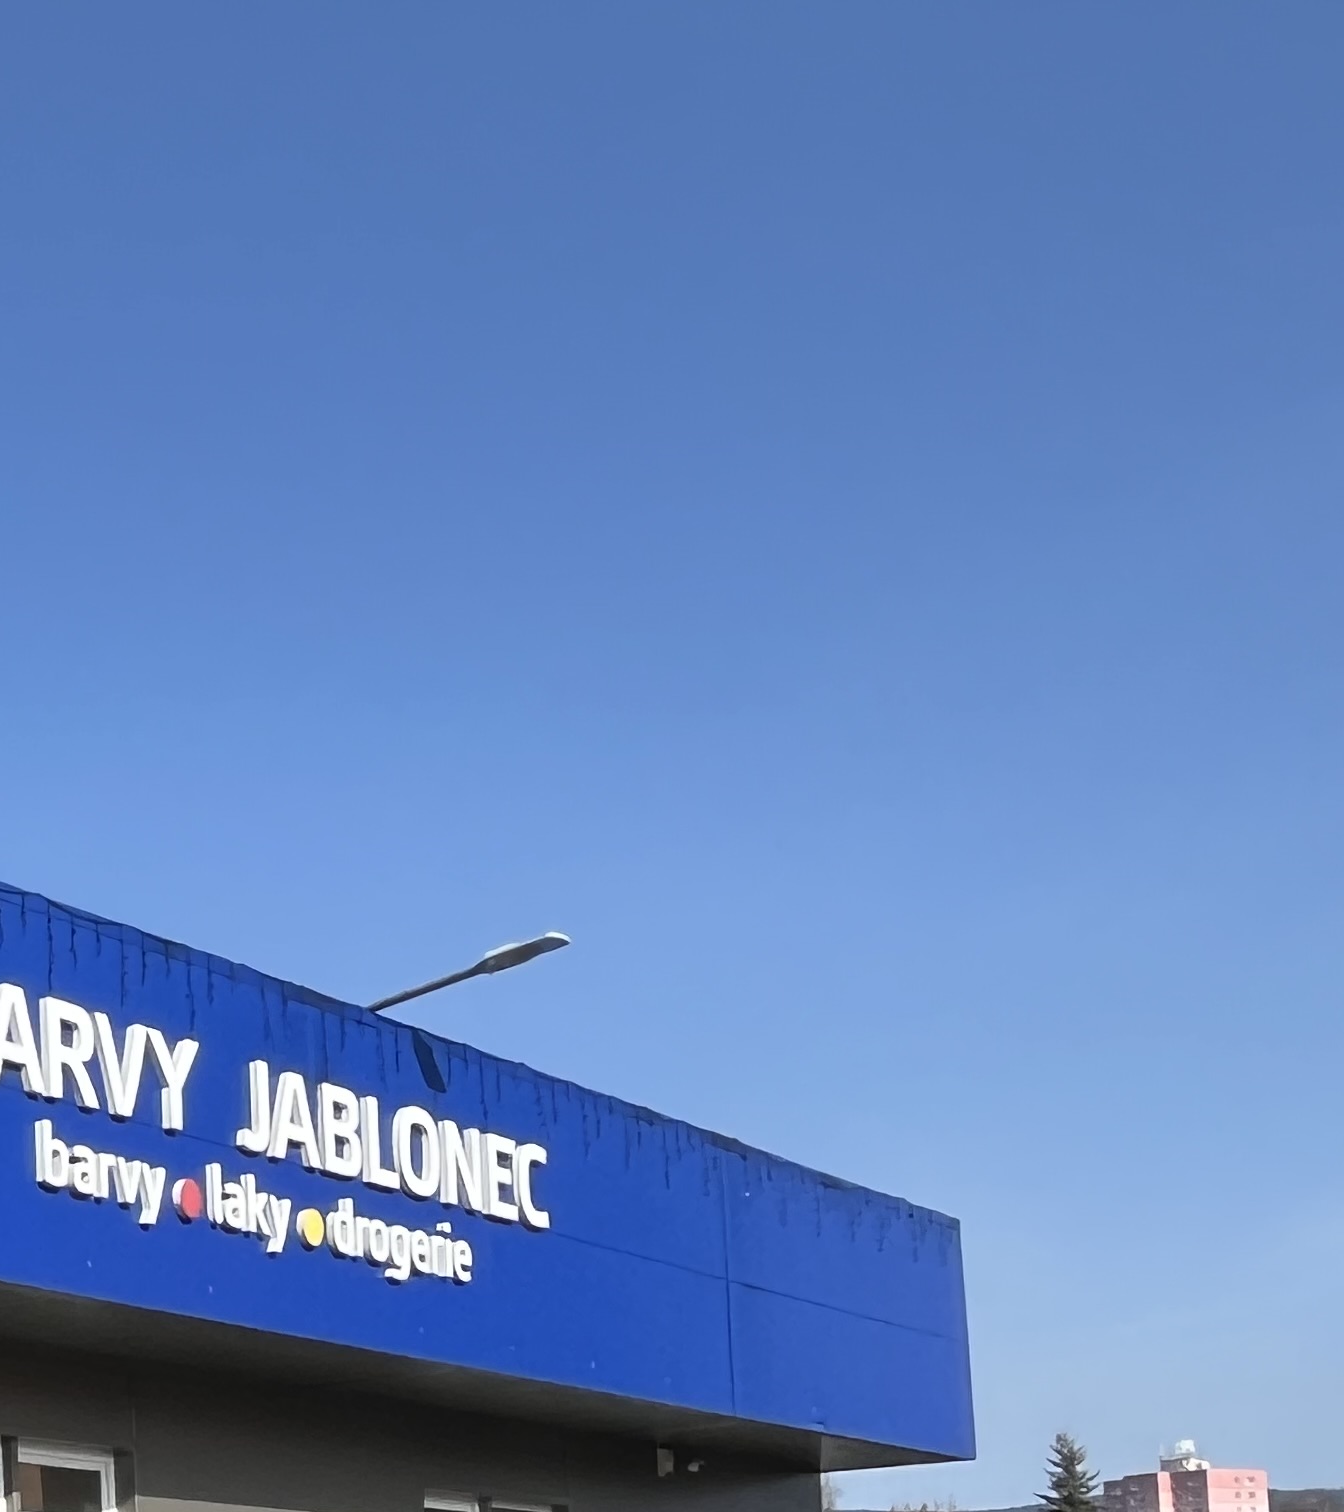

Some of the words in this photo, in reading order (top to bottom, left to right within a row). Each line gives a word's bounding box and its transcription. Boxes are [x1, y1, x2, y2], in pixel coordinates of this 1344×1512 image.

[34, 1118, 167, 1226] barvy
[205, 1162, 291, 1254] laky
[325, 1197, 473, 1283] drogerie
[235, 1059, 550, 1230] JABLONEC
